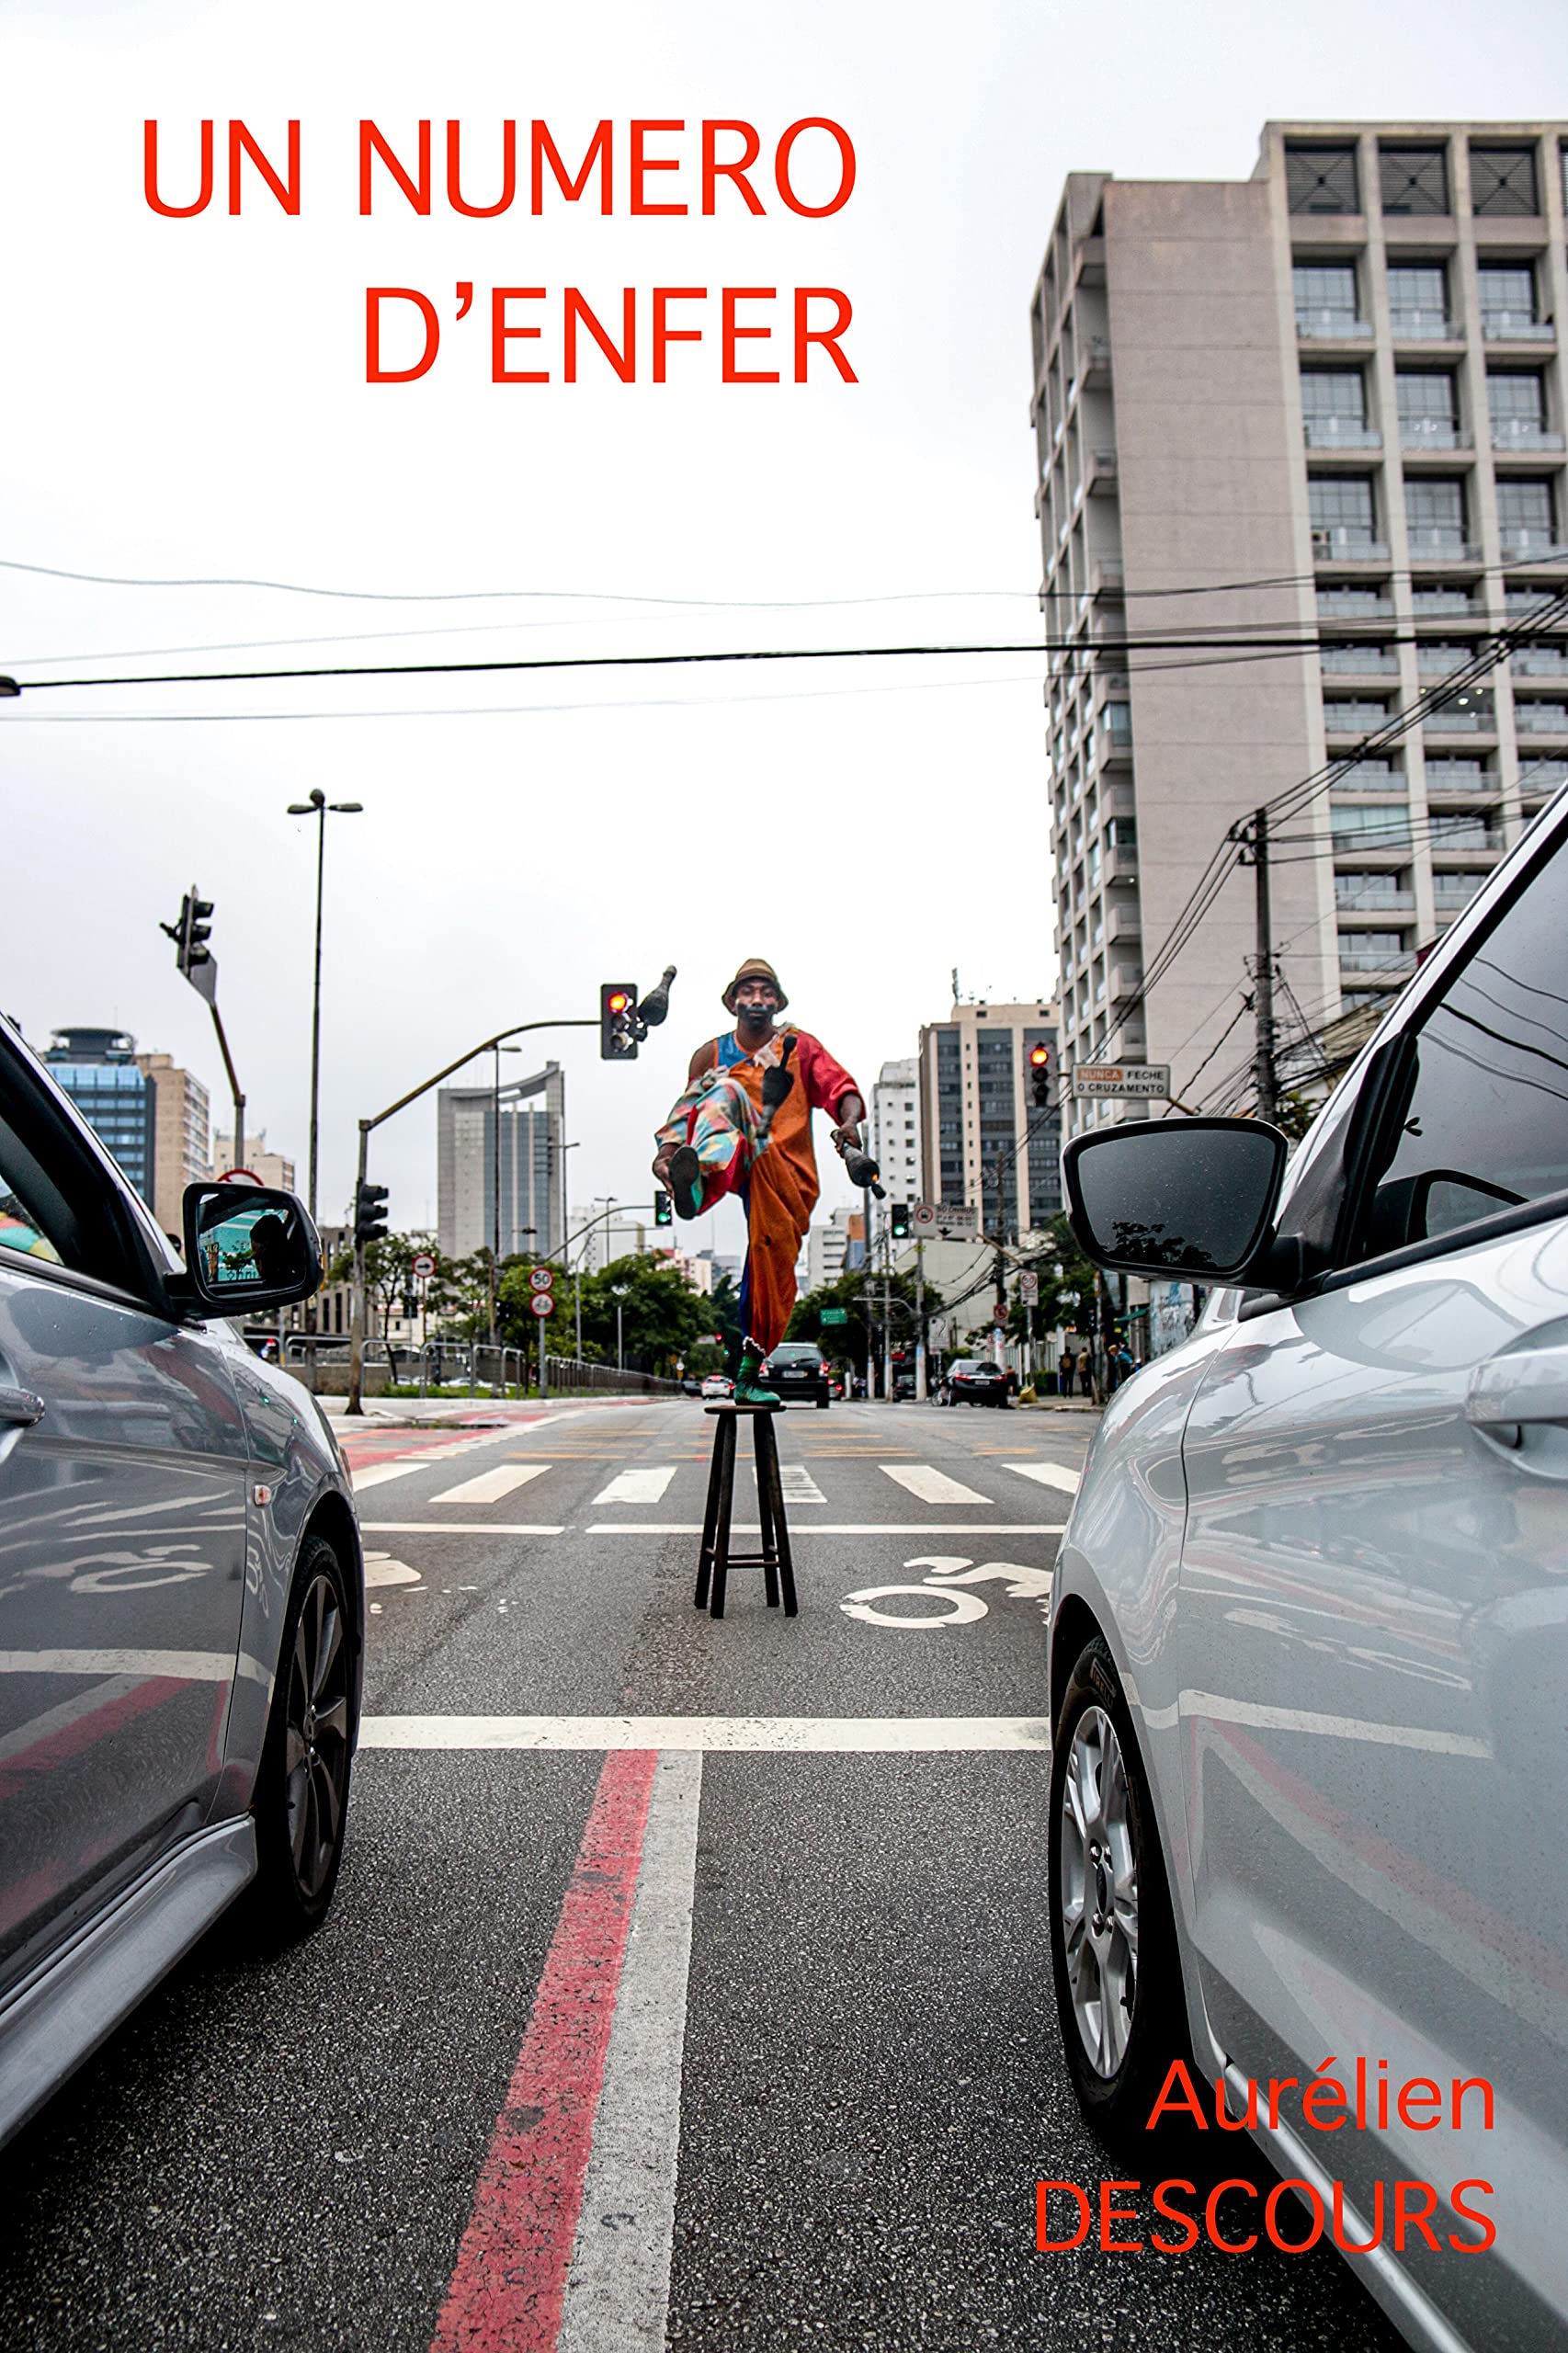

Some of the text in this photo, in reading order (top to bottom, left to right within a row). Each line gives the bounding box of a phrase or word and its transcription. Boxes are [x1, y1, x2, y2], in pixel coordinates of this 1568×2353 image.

[1080, 1069, 1165, 1080] NUNCA FECHE
[1077, 1083, 1165, 1093] O CRUZAMENTO
[534, 1273, 551, 1285] 50
